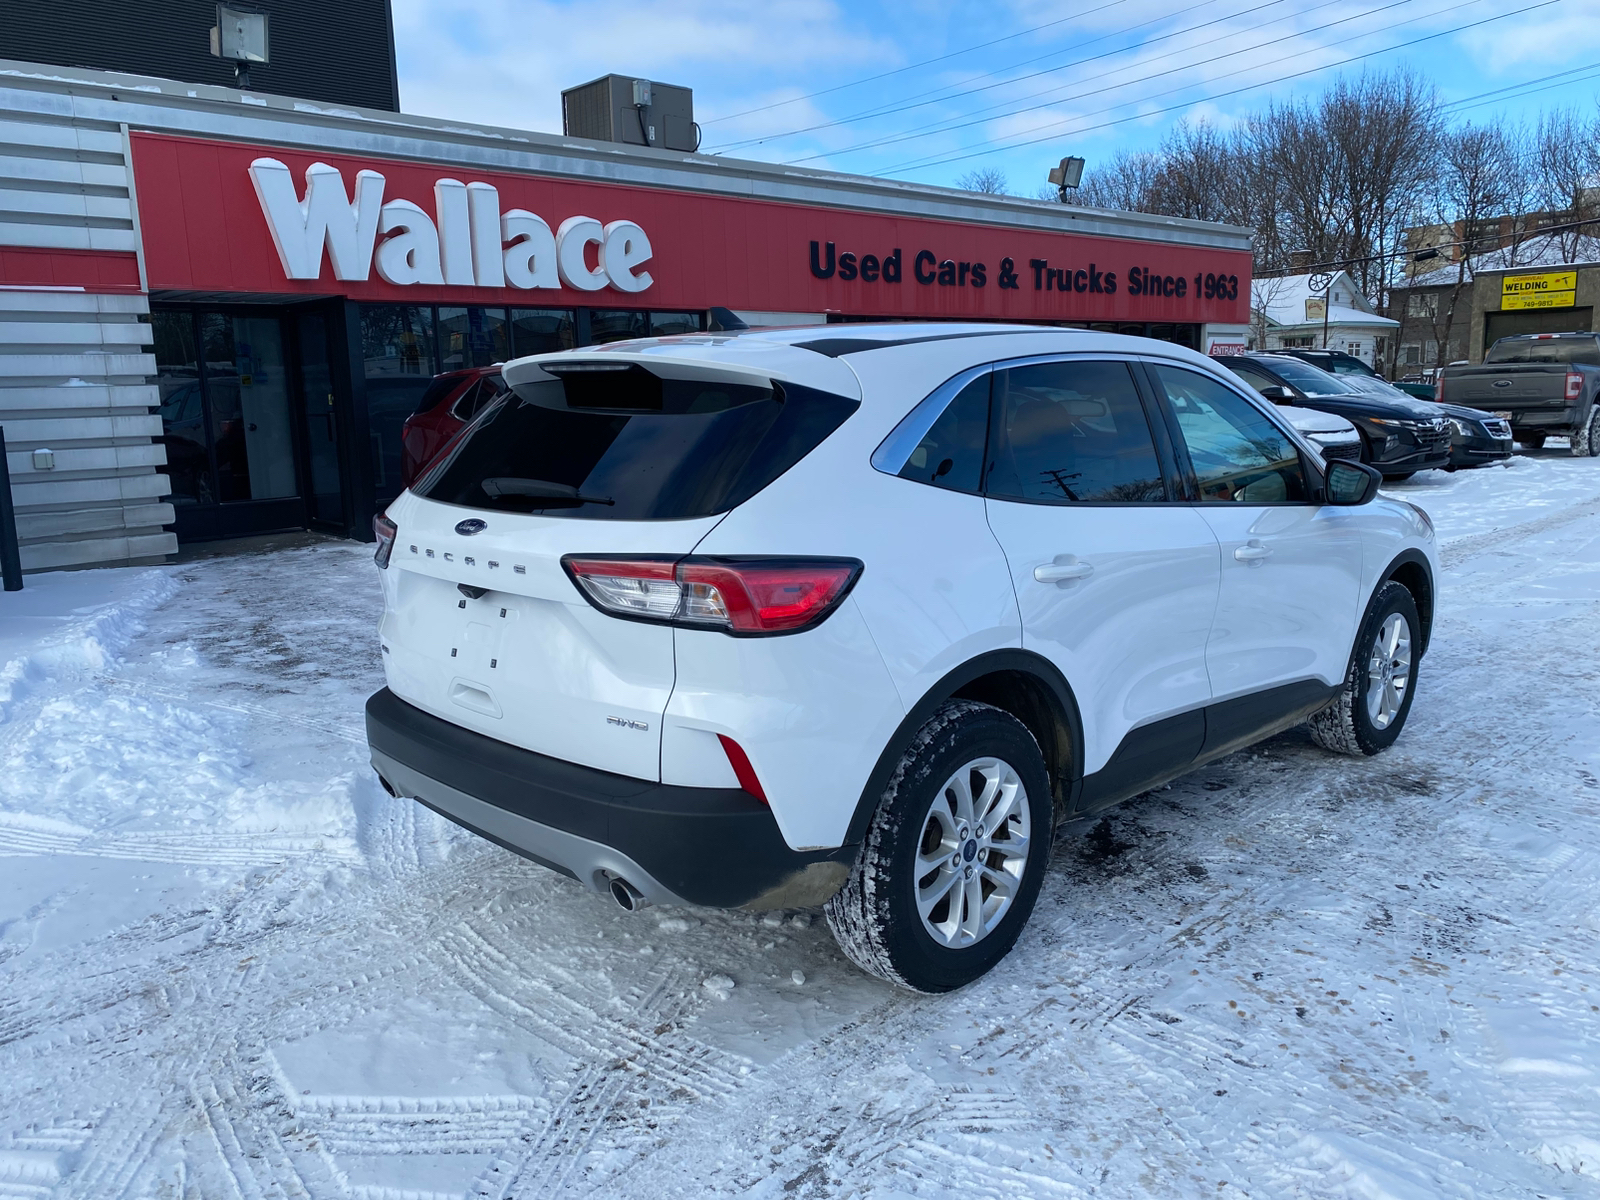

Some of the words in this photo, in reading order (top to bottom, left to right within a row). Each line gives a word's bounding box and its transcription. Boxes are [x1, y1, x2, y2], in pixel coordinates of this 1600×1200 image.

[248, 157, 654, 293] Wallace
[809, 240, 902, 283] Used
[914, 250, 988, 288] Cars
[998, 256, 1020, 290] &
[1030, 258, 1118, 295] Trucks
[1128, 266, 1188, 298] Since
[1194, 272, 1239, 301] 1963
[1505, 281, 1548, 292] WELDING
[1523, 300, 1554, 308] 749-9813
[1212, 345, 1245, 356] ENTRANCE
[409, 544, 527, 575] ESCAPE
[606, 715, 649, 732] AWD
